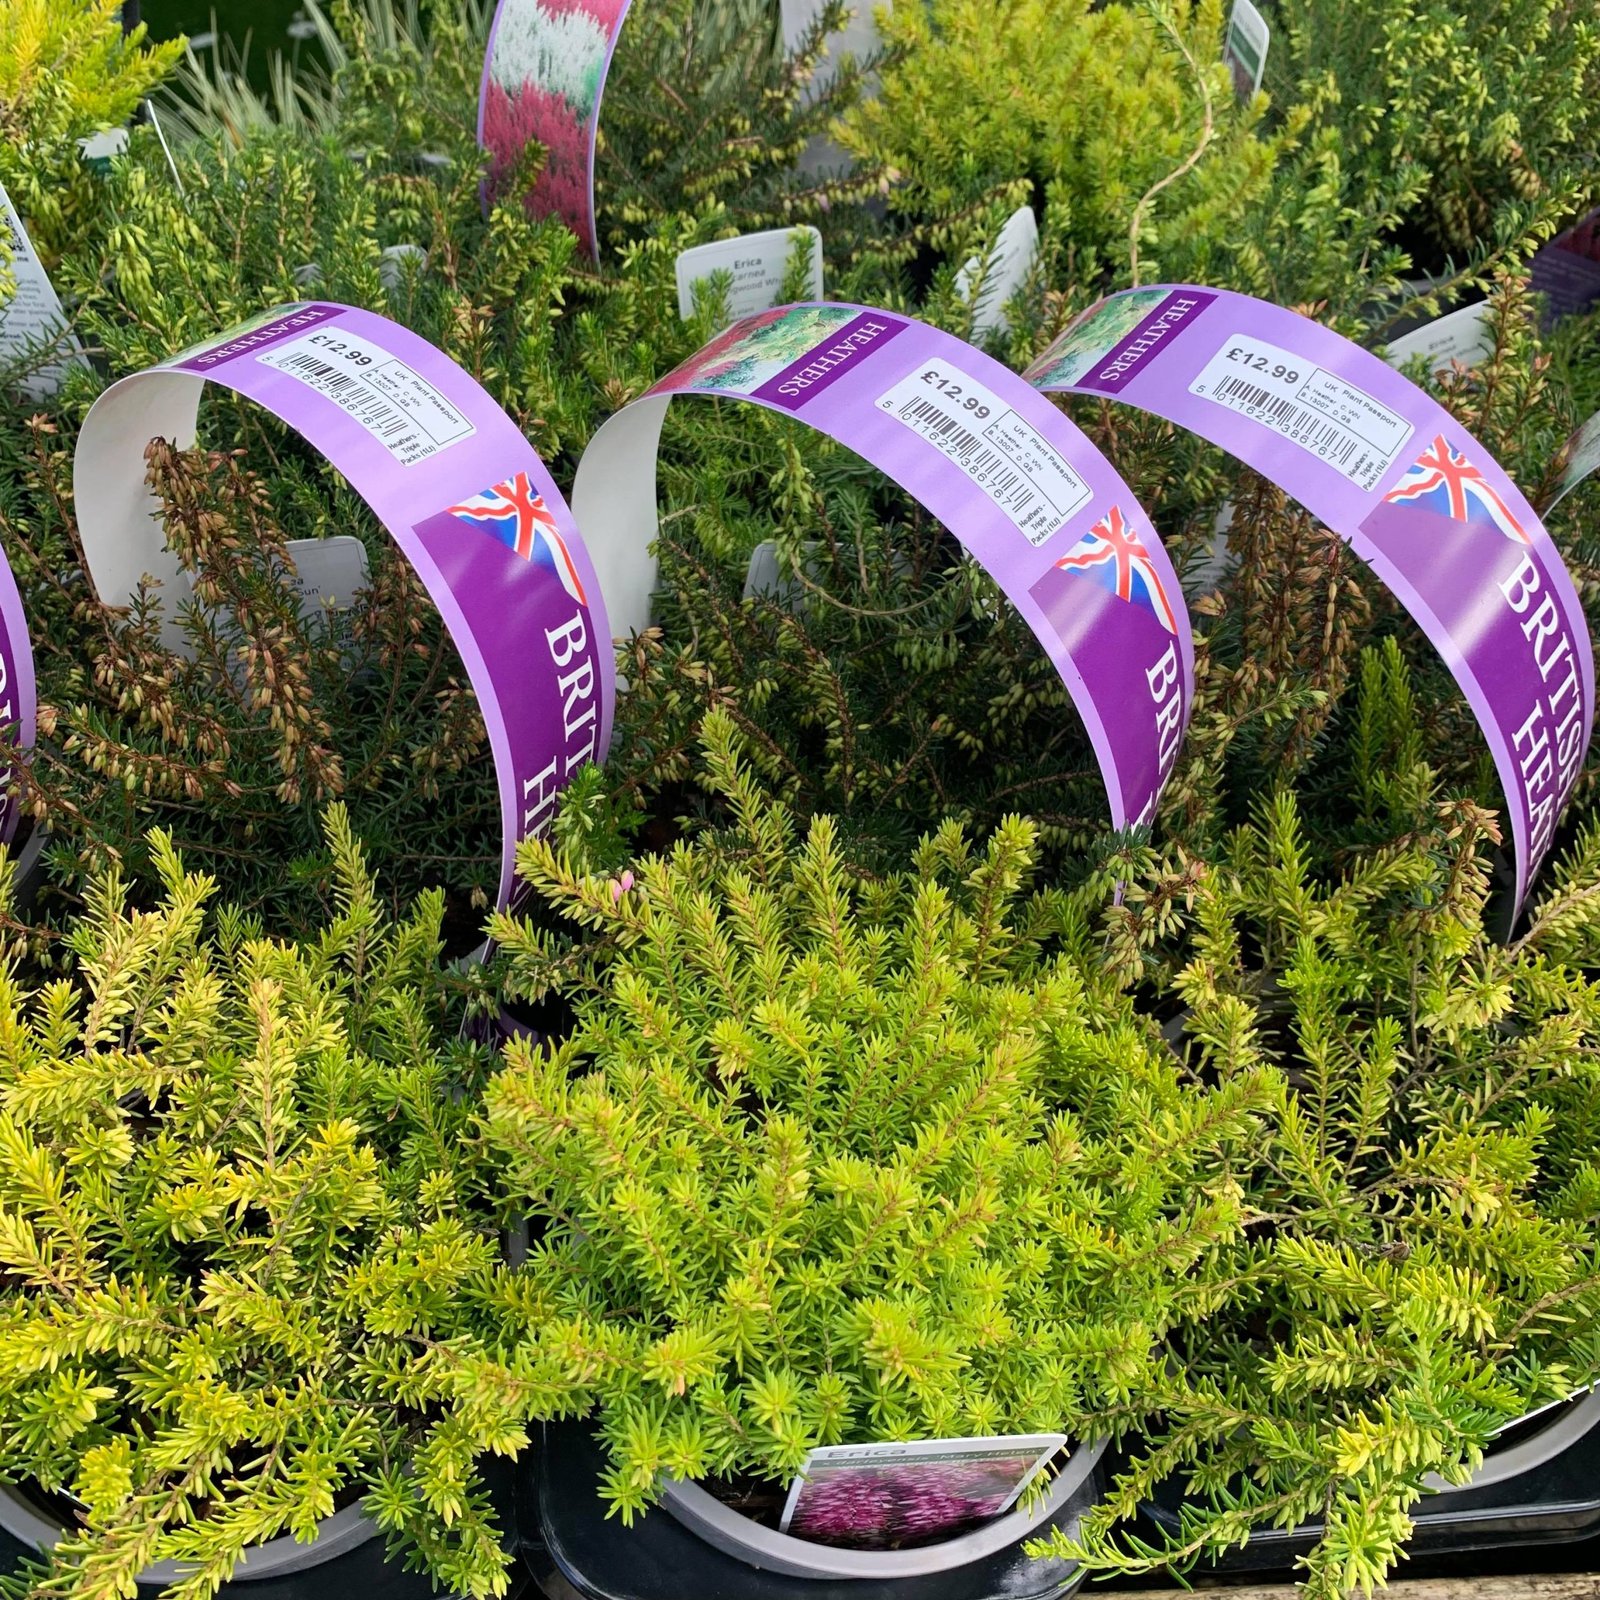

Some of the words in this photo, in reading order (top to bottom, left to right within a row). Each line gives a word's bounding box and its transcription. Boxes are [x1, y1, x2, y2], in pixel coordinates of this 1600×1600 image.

[734, 258, 762, 270] Erica
[197, 310, 326, 364] HEATHERS
[307, 334, 373, 367] £12.99
[1099, 298, 1198, 381] HEATHERS
[777, 321, 888, 397] HEATHERS
[1225, 347, 1300, 386] £12.99
[261, 355, 273, 363] 5
[278, 362, 331, 392] 011622
[330, 393, 382, 431] 386767
[394, 370, 409, 381] UK
[410, 380, 430, 397] Plant
[428, 395, 459, 425] Passport
[920, 369, 991, 420] £12.99
[1309, 396, 1330, 410] 13007
[1324, 381, 1339, 393] UK
[1342, 389, 1363, 405] Plant
[1362, 401, 1398, 428] Passport
[1196, 384, 1207, 394] 5
[1216, 392, 1276, 427] 011622
[1280, 423, 1338, 462] 386767
[387, 434, 417, 450] Heathers
[400, 442, 421, 454] Triple
[882, 400, 894, 409] 5
[901, 411, 958, 456] 011622
[960, 458, 1012, 506] 386767
[995, 436, 1014, 453] 13007
[400, 453, 421, 466] Packs
[1013, 425, 1028, 438] UK
[1030, 437, 1049, 457] Plant
[1048, 455, 1078, 489] Passport
[1347, 453, 1368, 478] Heathers
[1360, 461, 1375, 477] Triple
[1362, 473, 1379, 491] Packs
[1018, 505, 1044, 528] Heathers
[1030, 516, 1048, 531] Triple
[1030, 529, 1049, 545] Packs
[544, 608, 598, 777] BRIT
[827, 1449, 907, 1459] Erica
